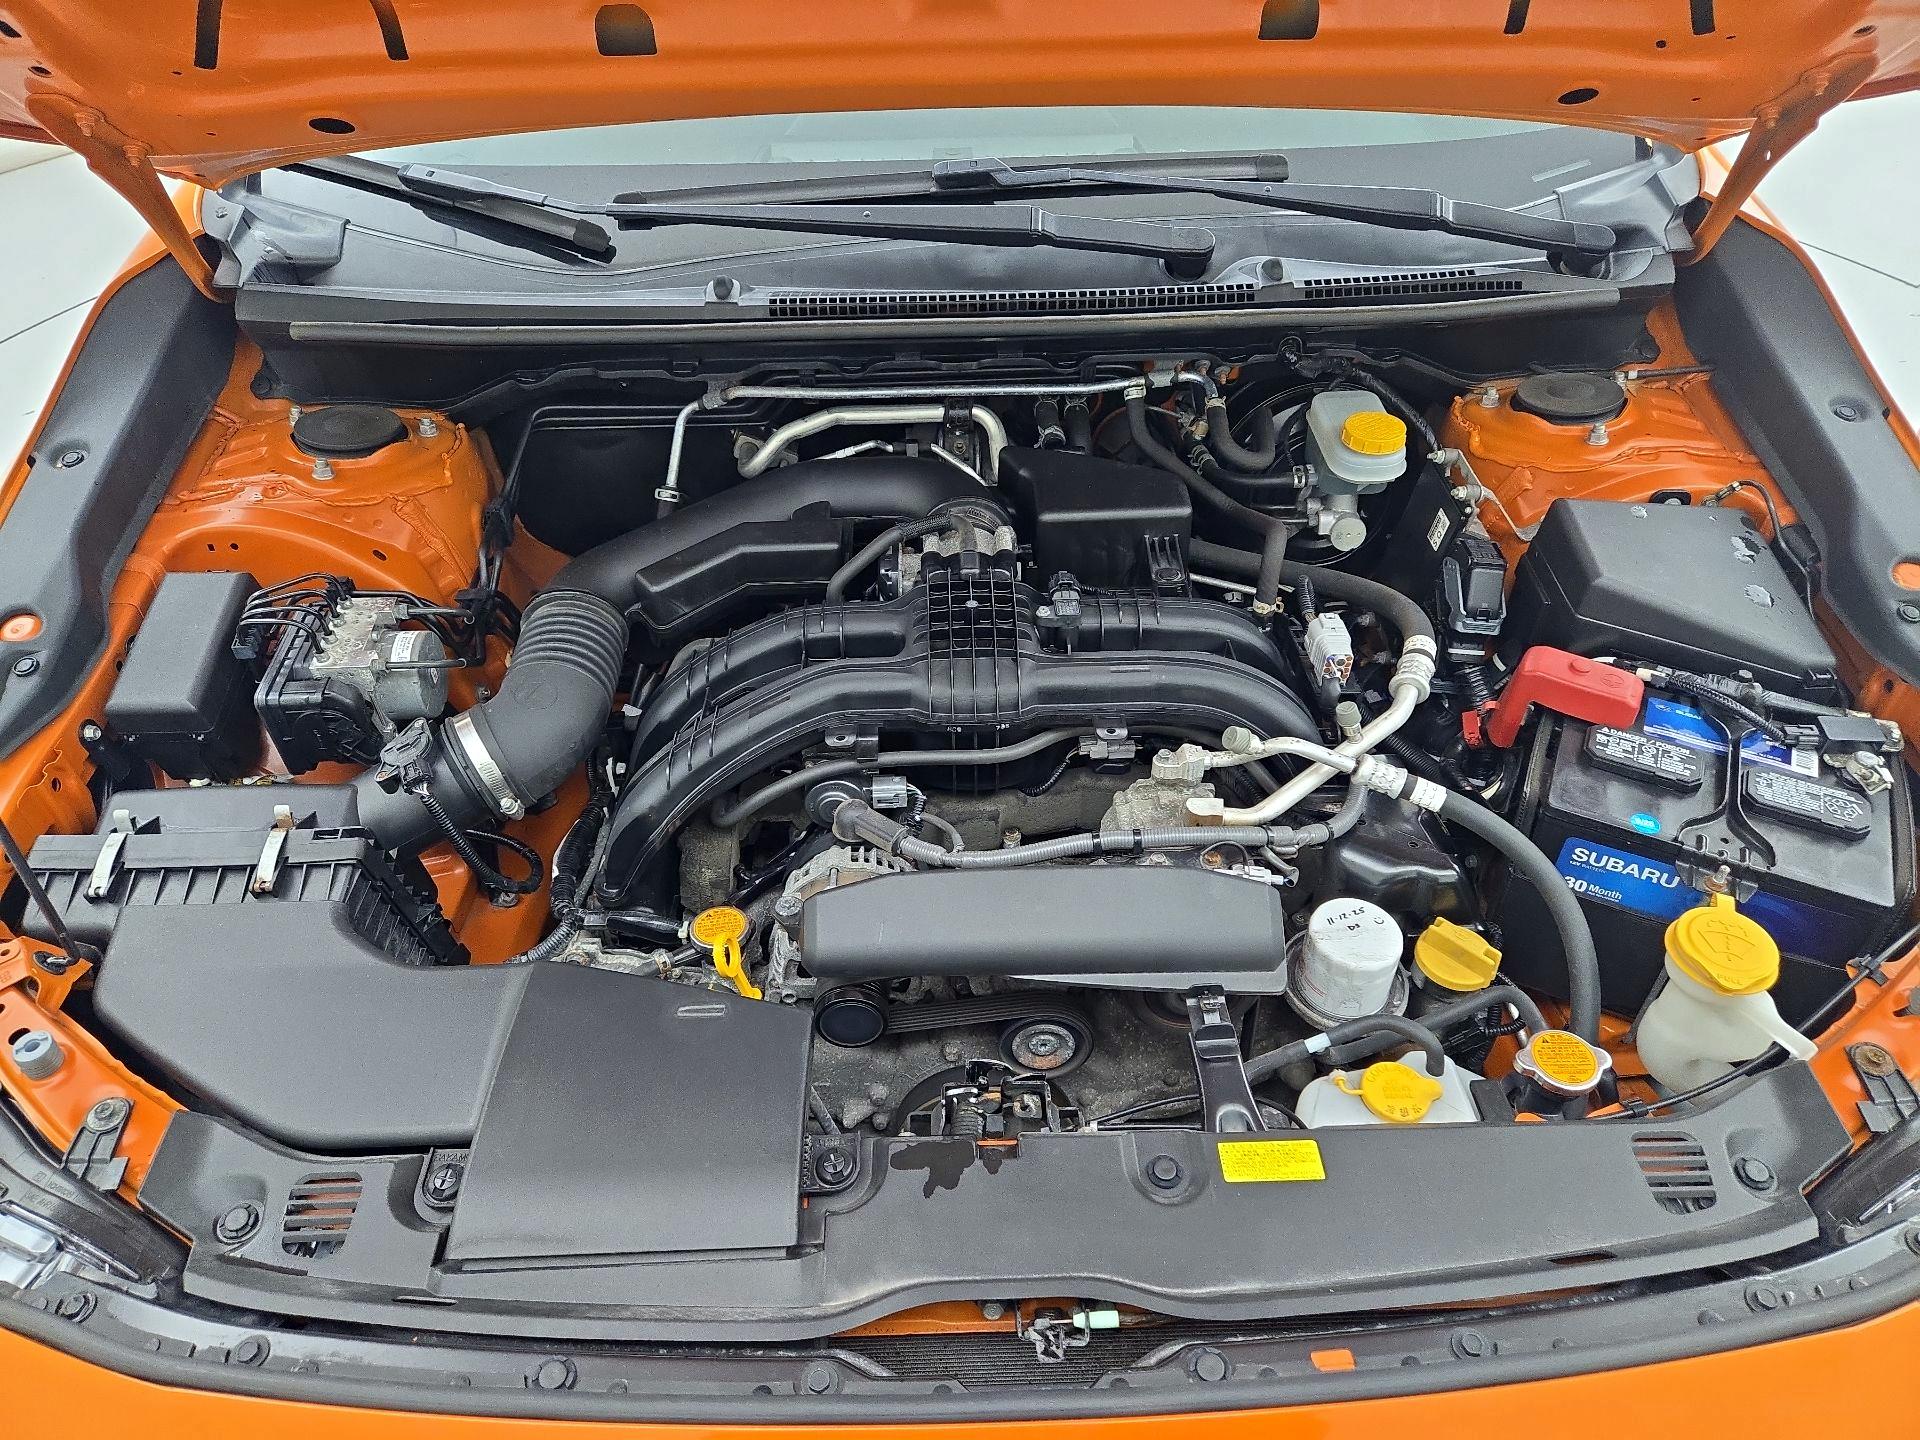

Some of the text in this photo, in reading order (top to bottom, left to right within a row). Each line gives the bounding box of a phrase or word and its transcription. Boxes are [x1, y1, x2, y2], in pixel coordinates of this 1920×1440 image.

[1572, 847, 1681, 888] SUBARU
[1564, 876, 1588, 893] 30
[1588, 884, 1623, 900] Month
